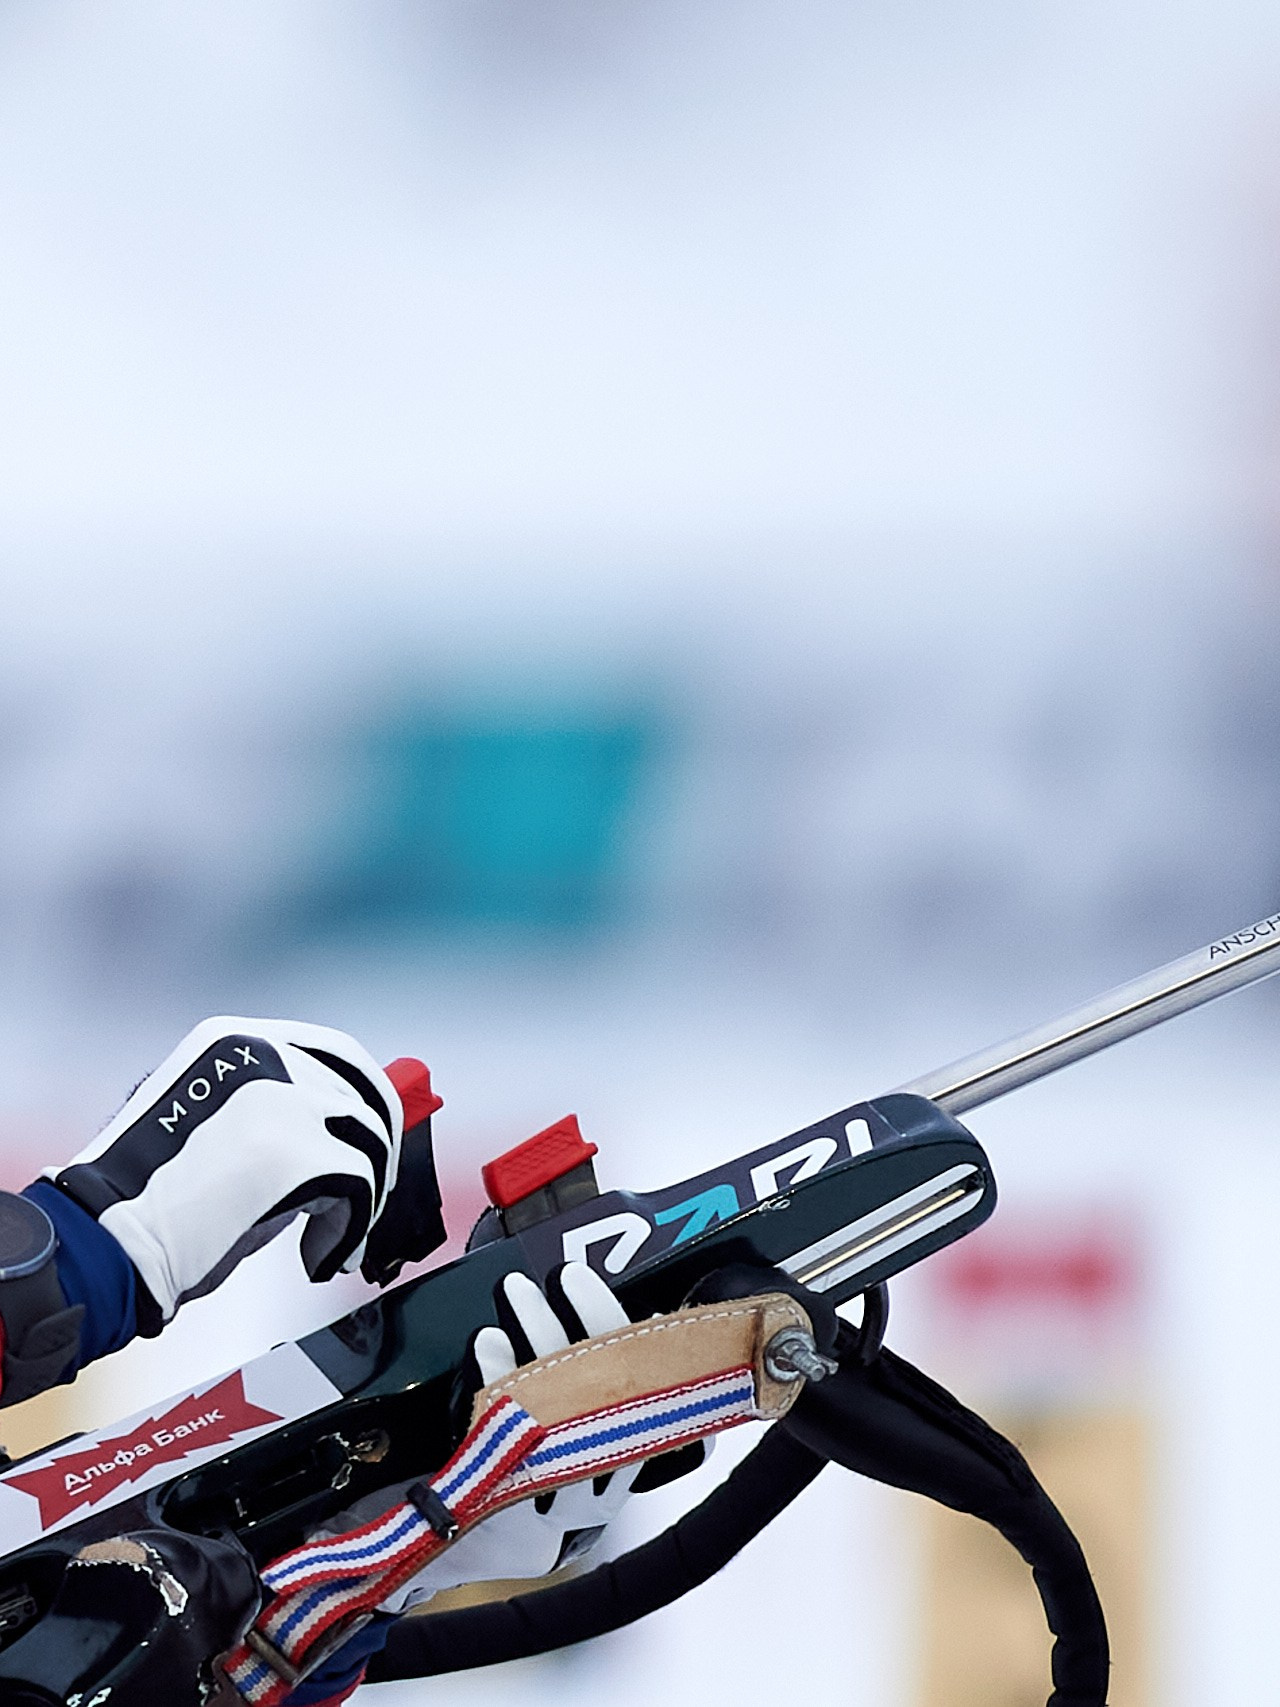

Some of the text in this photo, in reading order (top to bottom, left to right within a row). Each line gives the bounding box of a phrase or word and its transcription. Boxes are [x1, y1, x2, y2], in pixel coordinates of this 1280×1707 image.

[158, 1045, 261, 1133] MOAX
[63, 1408, 227, 1496] Альфа Банк
